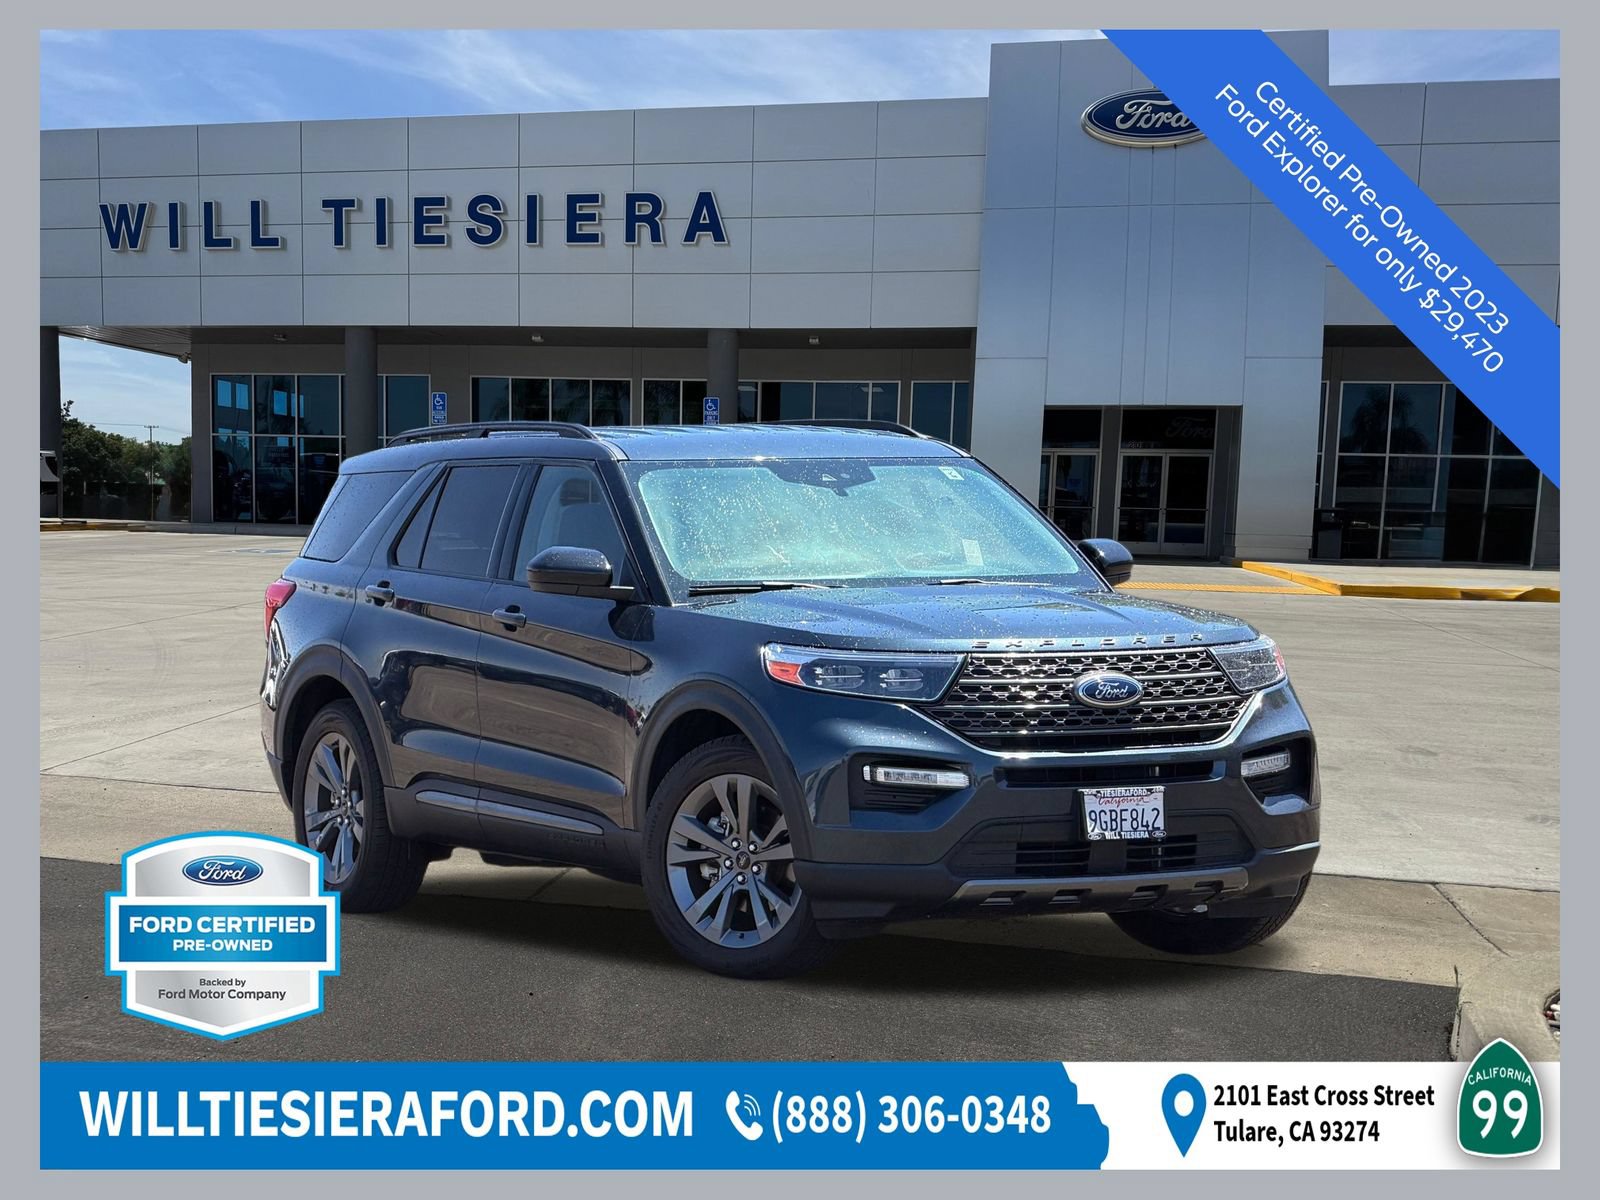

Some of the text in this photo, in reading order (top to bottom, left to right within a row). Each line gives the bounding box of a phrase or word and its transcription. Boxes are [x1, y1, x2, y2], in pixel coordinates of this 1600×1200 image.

[98, 189, 731, 251] WILL TIESIERA
[971, 632, 1203, 649] EXPLORER
[1095, 681, 1129, 700] Ford
[1098, 796, 1149, 808] California
[1088, 807, 1161, 833] 9GBF842
[1104, 832, 1120, 840] WILL
[1120, 831, 1150, 839] TIESIERA
